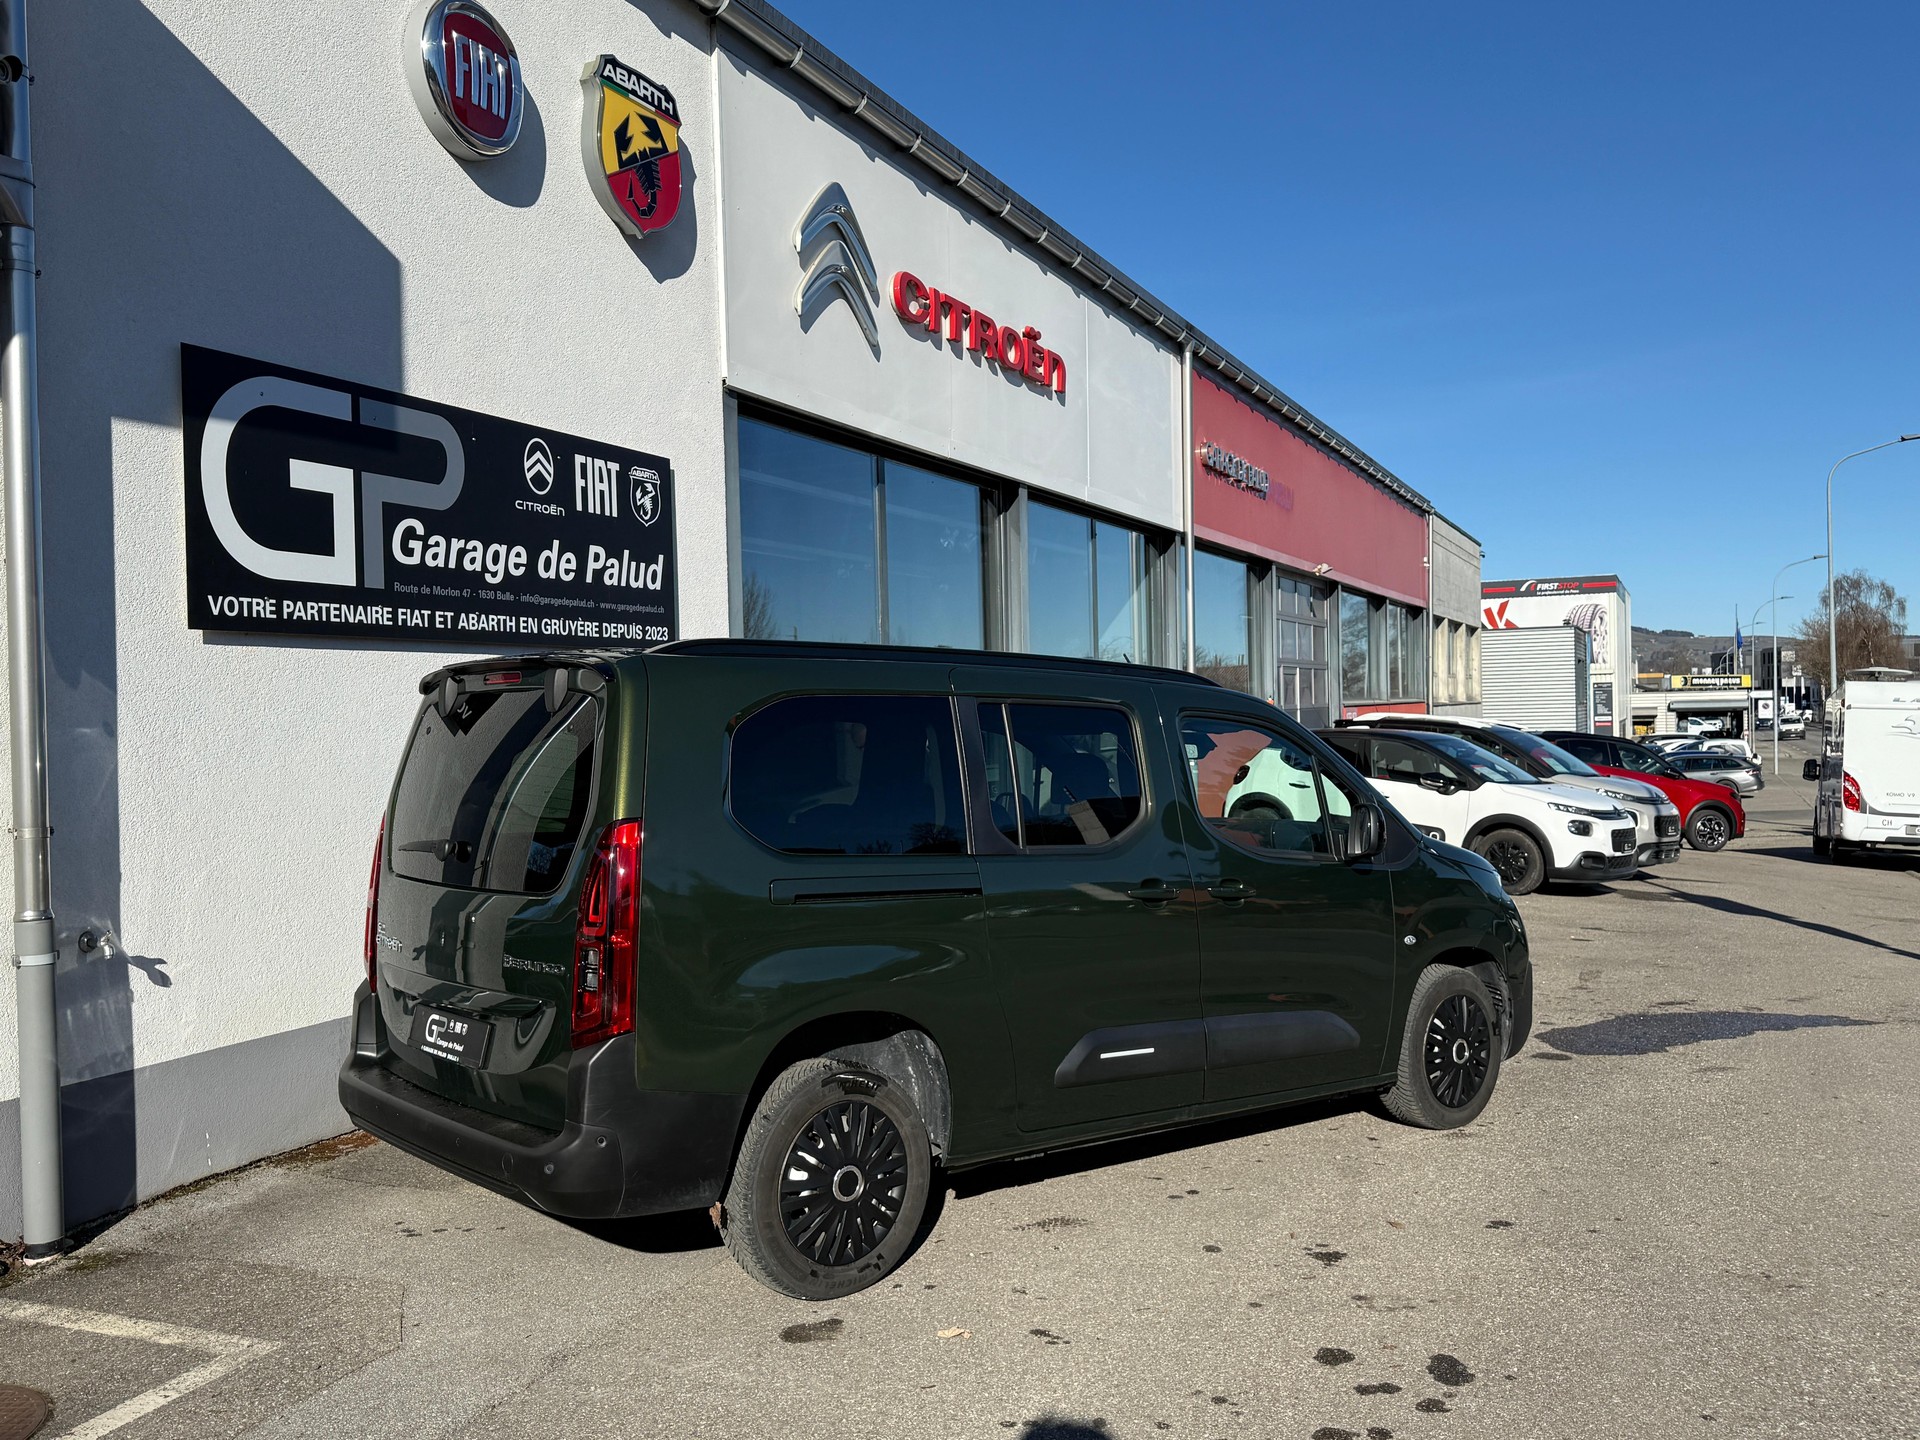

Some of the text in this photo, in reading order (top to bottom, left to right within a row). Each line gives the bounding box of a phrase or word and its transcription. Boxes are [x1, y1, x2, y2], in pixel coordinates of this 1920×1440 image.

[453, 31, 509, 120] FIAT
[602, 63, 674, 115] ABARTH
[574, 453, 620, 518] FIAT
[632, 469, 658, 480] ABARTH
[391, 518, 664, 591] Garage de Palud
[207, 595, 669, 641] VOTRE PARTENAIRE FIAT ET ABARTH EN GRUYÈRE DEPUIS 2023
[394, 582, 419, 594] Route
[420, 584, 431, 595] de
[432, 585, 461, 597] Morlon
[462, 589, 471, 598] 47
[478, 590, 495, 600] 1630
[496, 591, 515, 601] Bulle
[520, 593, 595, 608] info@garagedepalud.ch
[599, 602, 665, 614] www.garagedepalud.ch
[1881, 817, 1893, 827] CH
